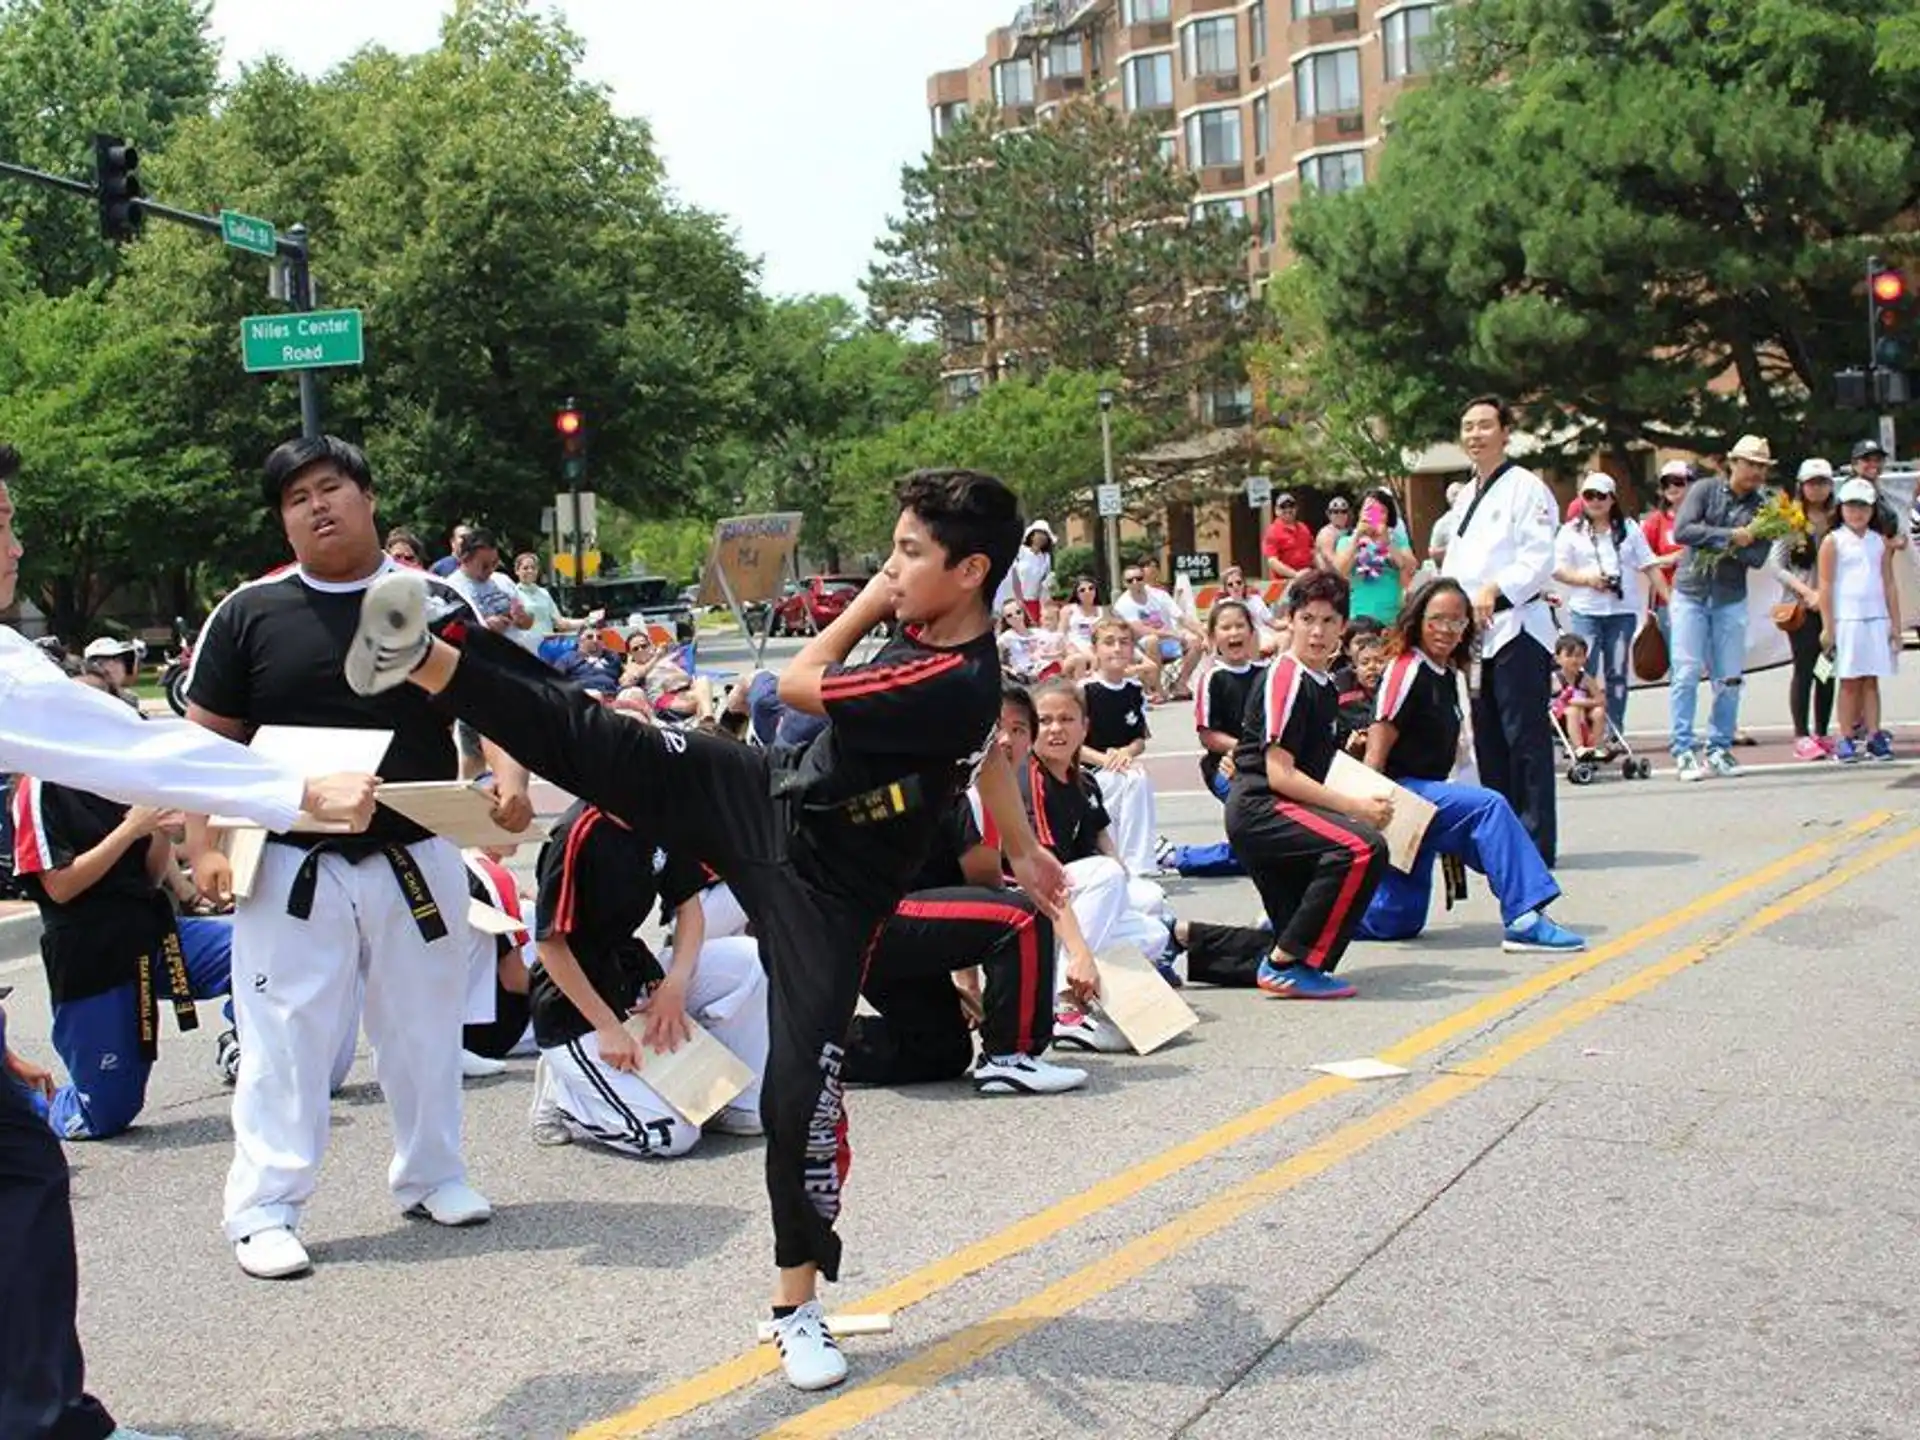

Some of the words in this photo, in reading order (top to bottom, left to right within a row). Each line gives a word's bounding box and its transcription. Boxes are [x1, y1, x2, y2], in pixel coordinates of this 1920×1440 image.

[251, 322, 290, 340] Niles
[297, 318, 350, 336] Center
[282, 344, 323, 362] Road
[805, 1041, 845, 1162] LEDERSHIP
